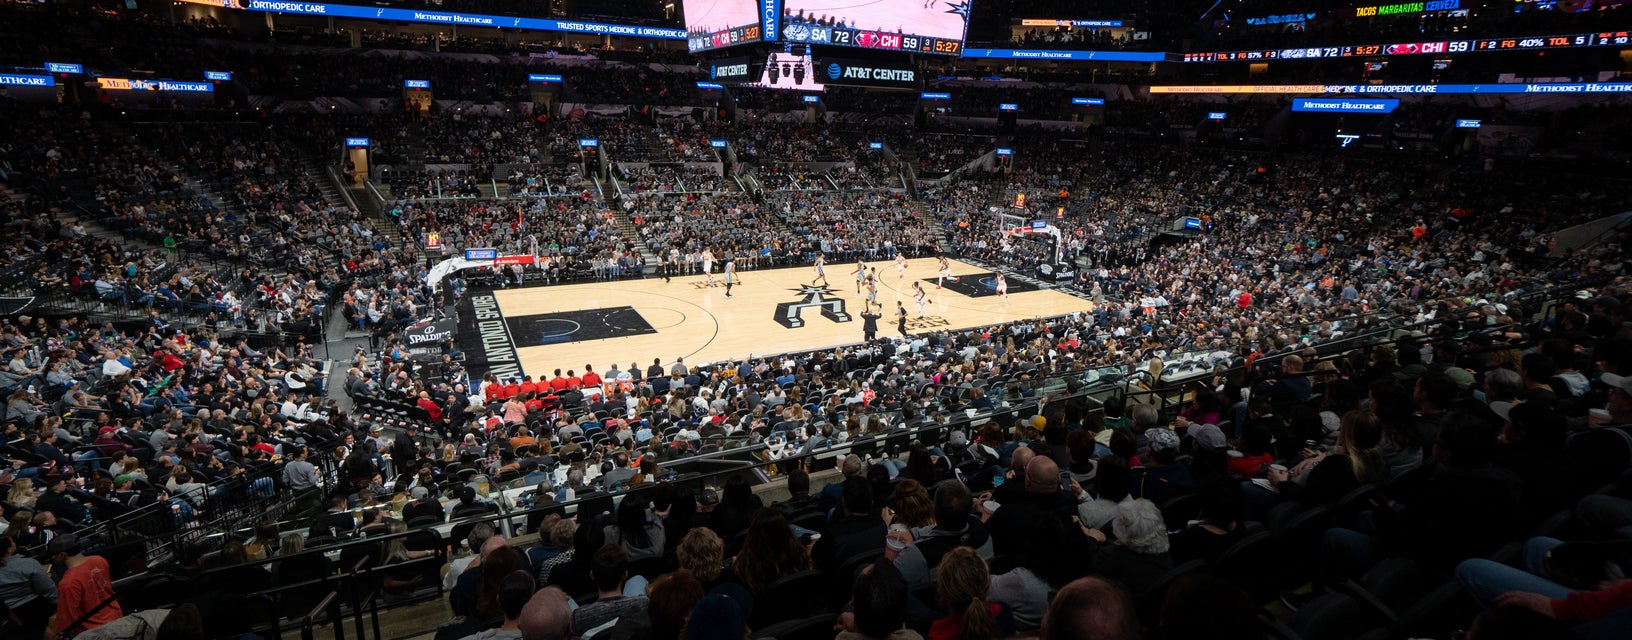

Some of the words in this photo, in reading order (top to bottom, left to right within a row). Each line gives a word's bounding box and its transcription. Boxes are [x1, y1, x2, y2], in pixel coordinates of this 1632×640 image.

[253, 1, 303, 12] ORTHOPEDIC
[305, 4, 326, 13] CARE
[1356, 6, 1377, 16] TACOS
[1378, 2, 1424, 15] MARGARITAS
[1426, 0, 1460, 11] CERVEZA
[414, 12, 452, 22] METHODIST
[454, 15, 493, 24] HEALTHCARE
[556, 22, 584, 30] TRUSTED
[585, 24, 608, 32] SPORTS
[609, 26, 636, 34] MEDICINE
[644, 28, 677, 37] ORTHOPEDIC
[730, 31, 737, 42] 59
[811, 31, 827, 41] SA
[834, 31, 849, 43] 72
[881, 36, 899, 47] CHI
[903, 38, 917, 49] 59
[936, 41, 958, 53] 5:27
[1306, 48, 1320, 57] SA
[1324, 48, 1338, 57] 72
[1356, 46, 1380, 55] 5:27
[1421, 43, 1444, 53] CHI
[1449, 41, 1468, 52] 59
[1519, 38, 1544, 47] 40%
[1549, 38, 1570, 46] TOL
[1575, 36, 1584, 45] 5
[728, 64, 747, 76] CENTER
[844, 66, 872, 78] AT&T
[873, 69, 914, 81] CENTER
[158, 82, 208, 91] HEALTHCARE
[472, 296, 500, 319] SPURS
[478, 320, 515, 362] ANTONIO
